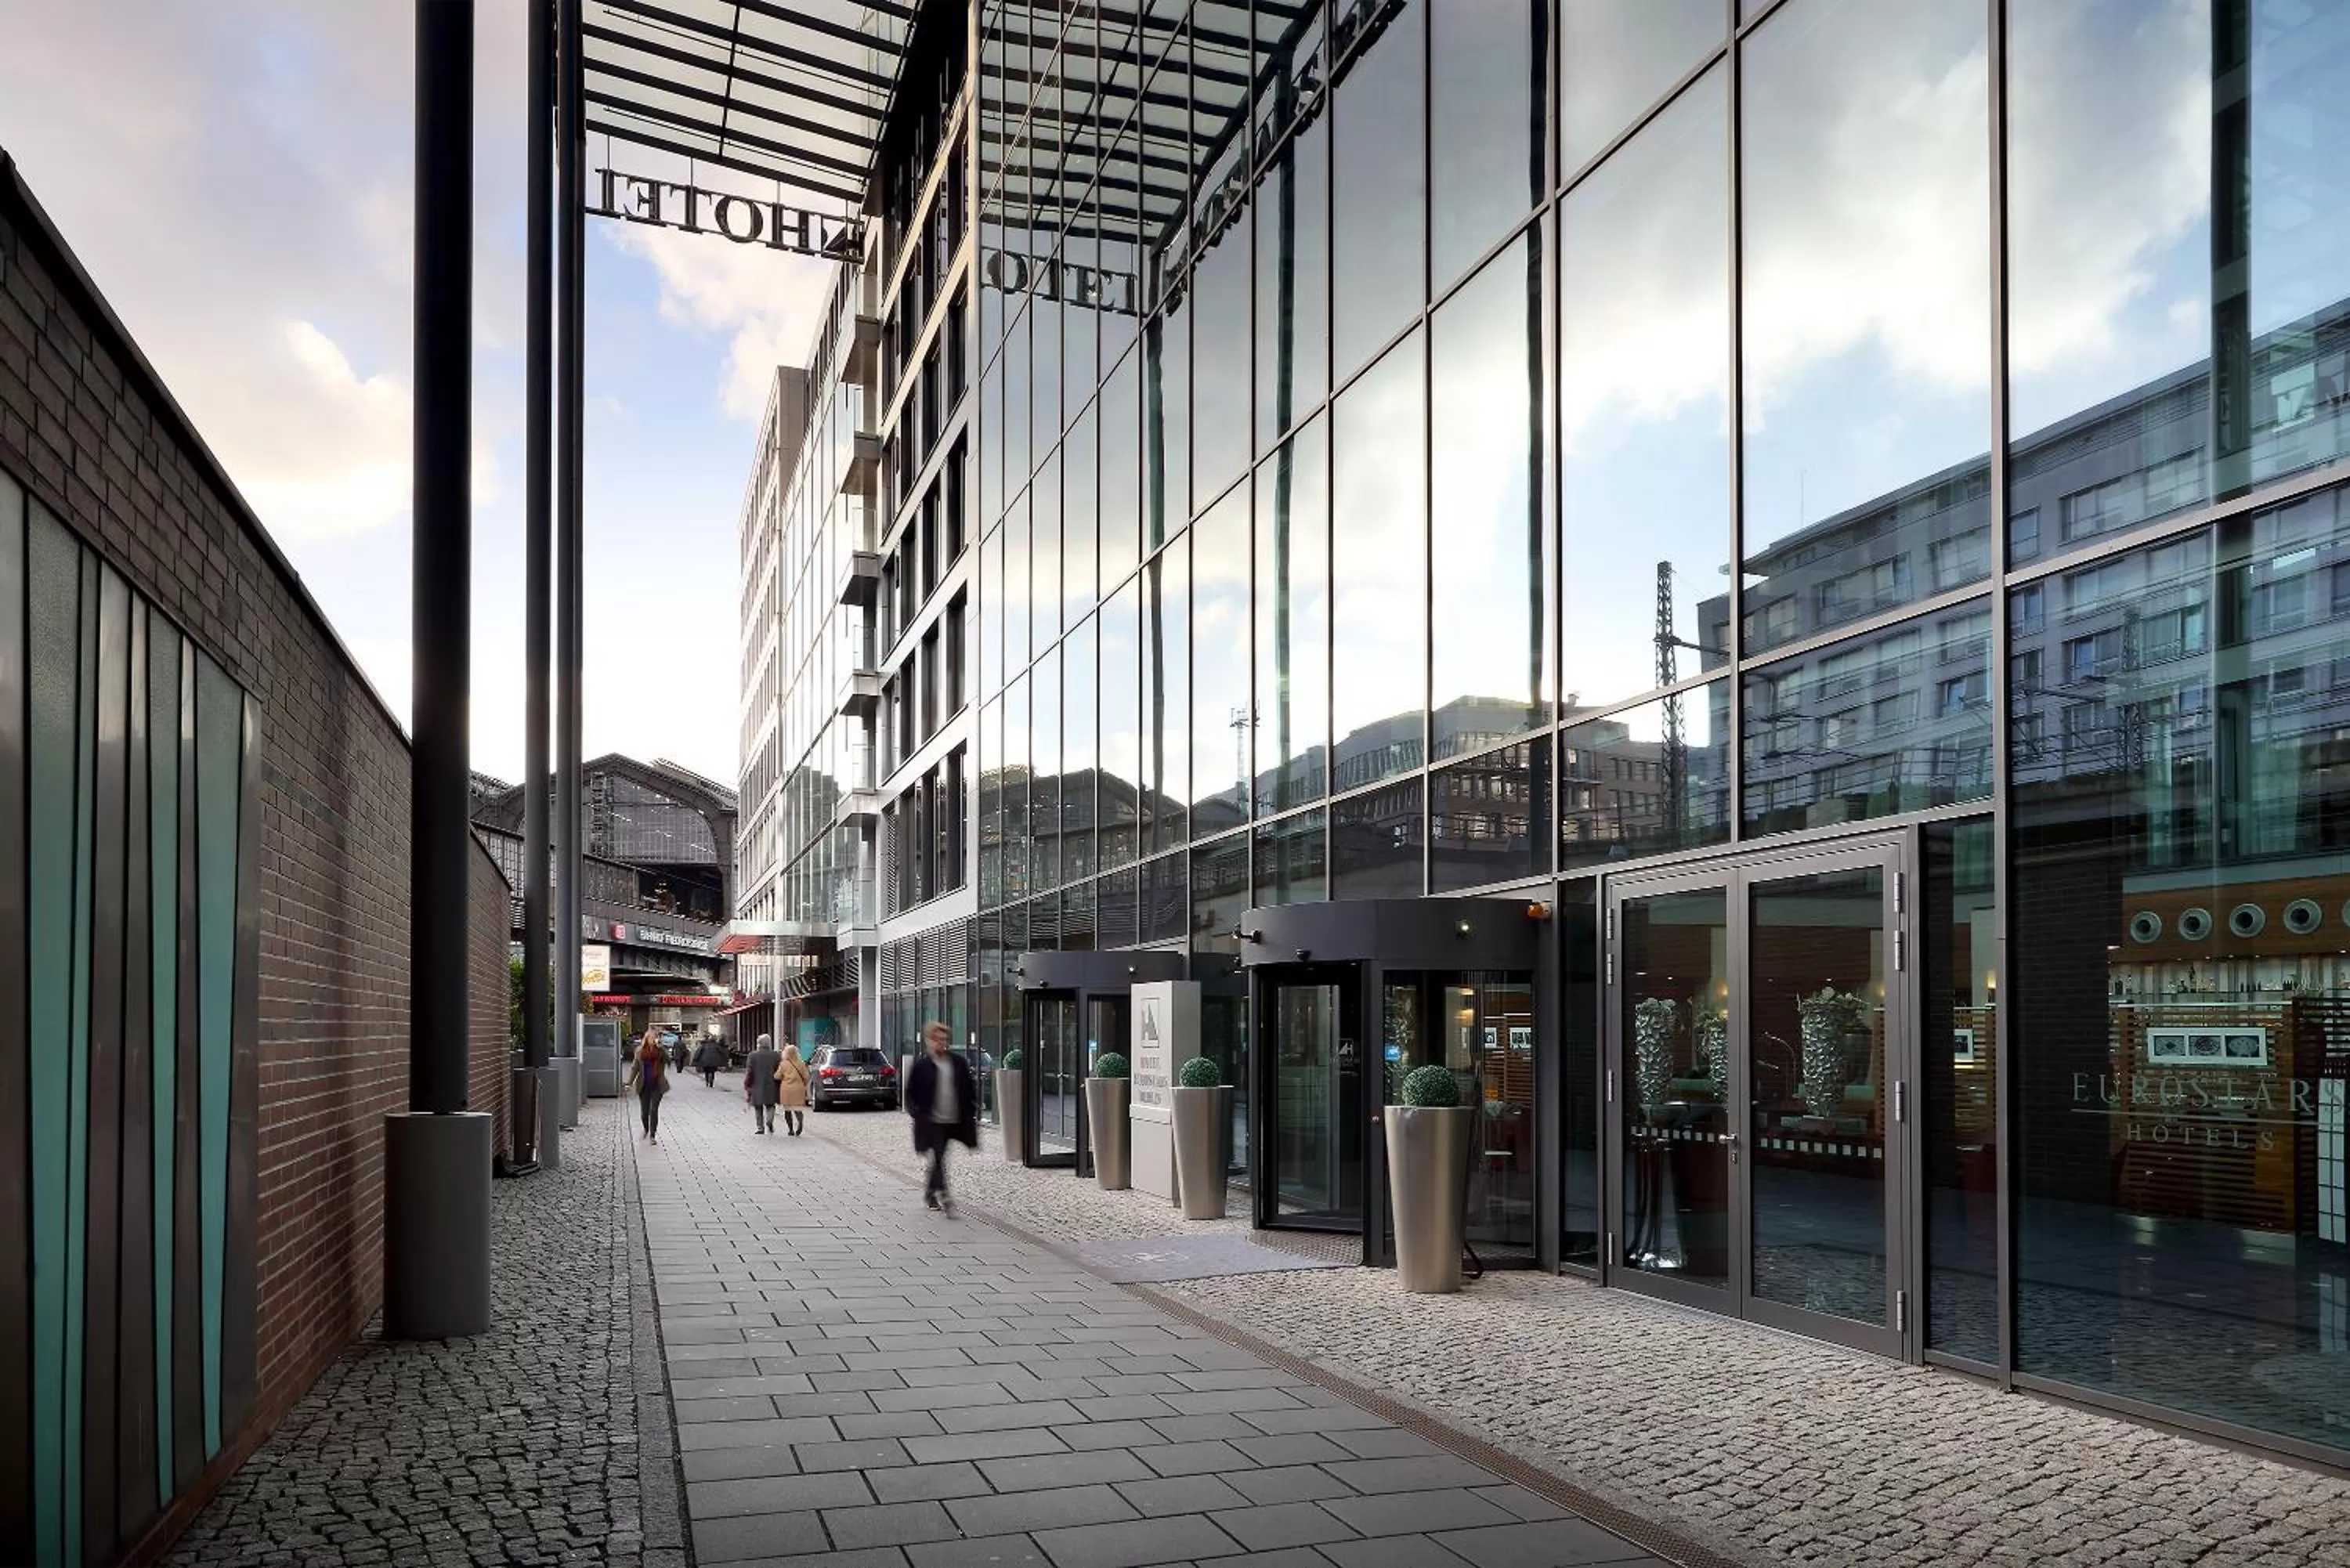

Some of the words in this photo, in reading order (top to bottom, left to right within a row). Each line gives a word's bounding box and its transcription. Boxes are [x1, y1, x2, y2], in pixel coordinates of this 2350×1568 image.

[985, 250, 1144, 317] OTEL
[2072, 1071, 2343, 1115] EUROSTARS
[2127, 1123, 2276, 1151] HOTELS
